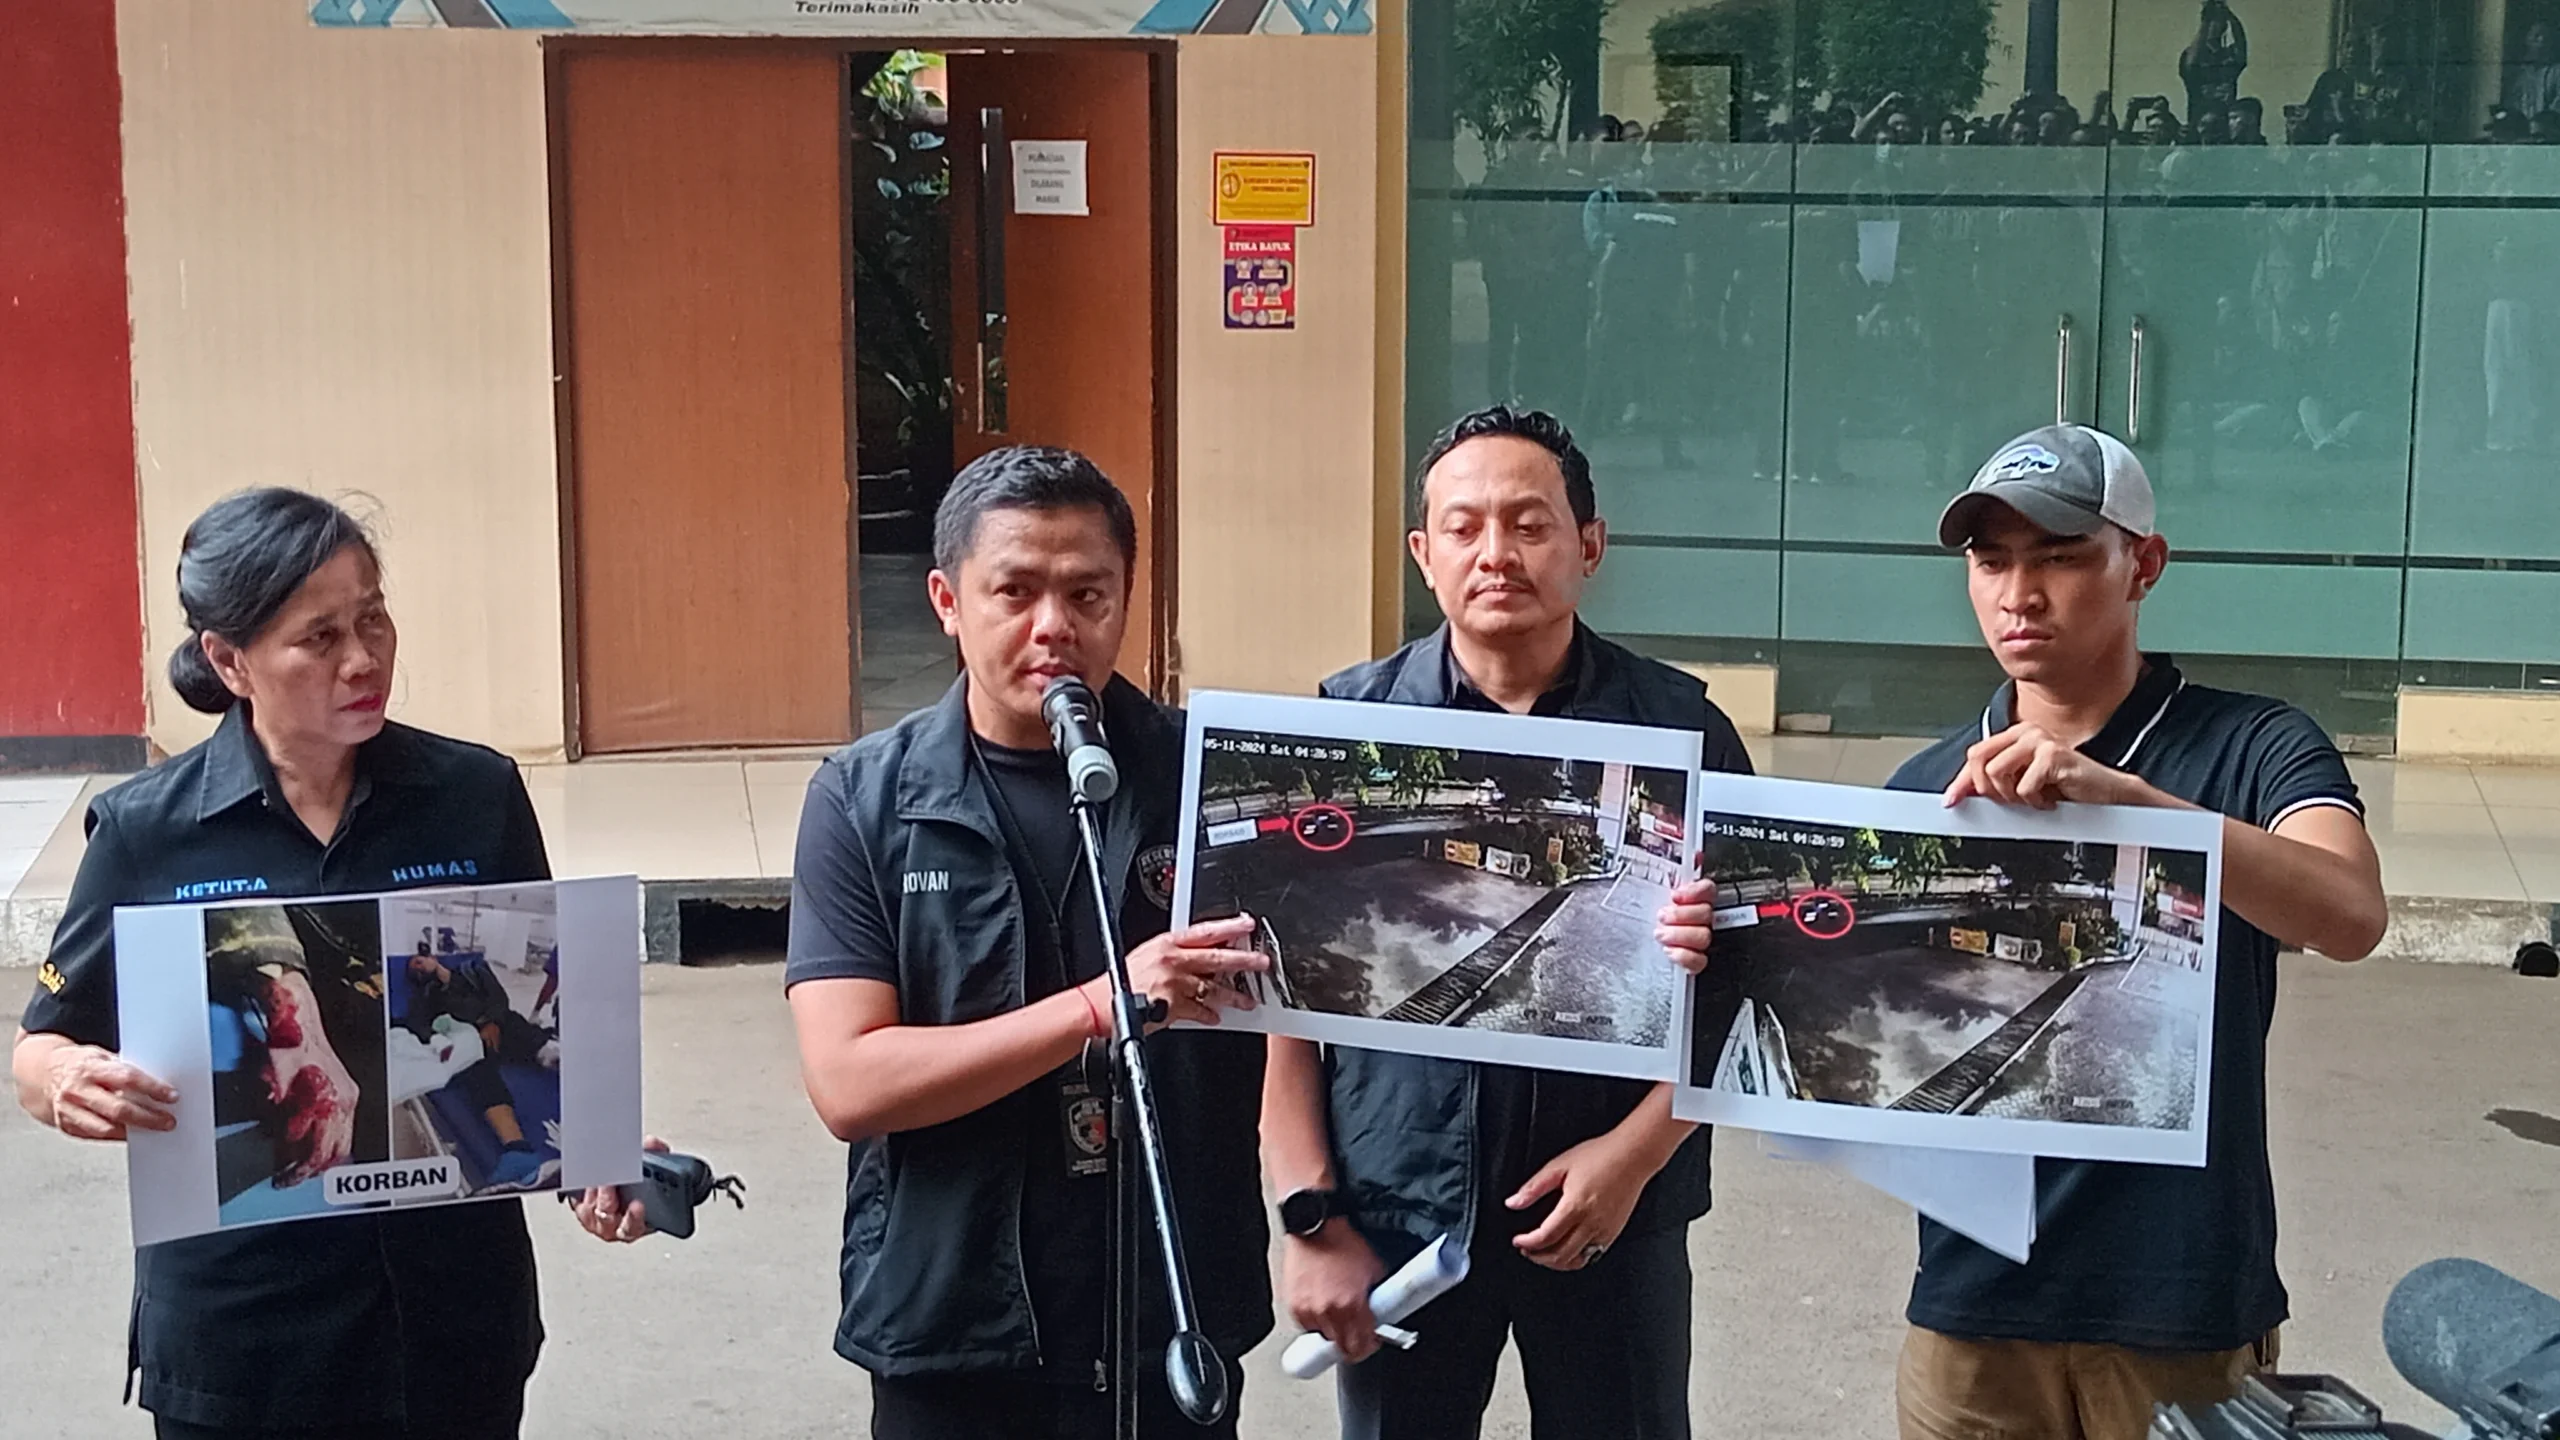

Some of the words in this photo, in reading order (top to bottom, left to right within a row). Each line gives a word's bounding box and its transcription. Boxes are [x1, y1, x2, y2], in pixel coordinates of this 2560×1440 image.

[795, 1, 920, 15] Terimakasih
[1228, 242, 1258, 251] ETIKA
[1260, 242, 1291, 251] BATUK
[1203, 738, 1267, 754] 05-11-2024
[1270, 744, 1291, 756] Sat
[1768, 829, 1789, 843] Sat
[392, 859, 478, 882] HUMAS
[335, 1166, 447, 1194] KORBAN
